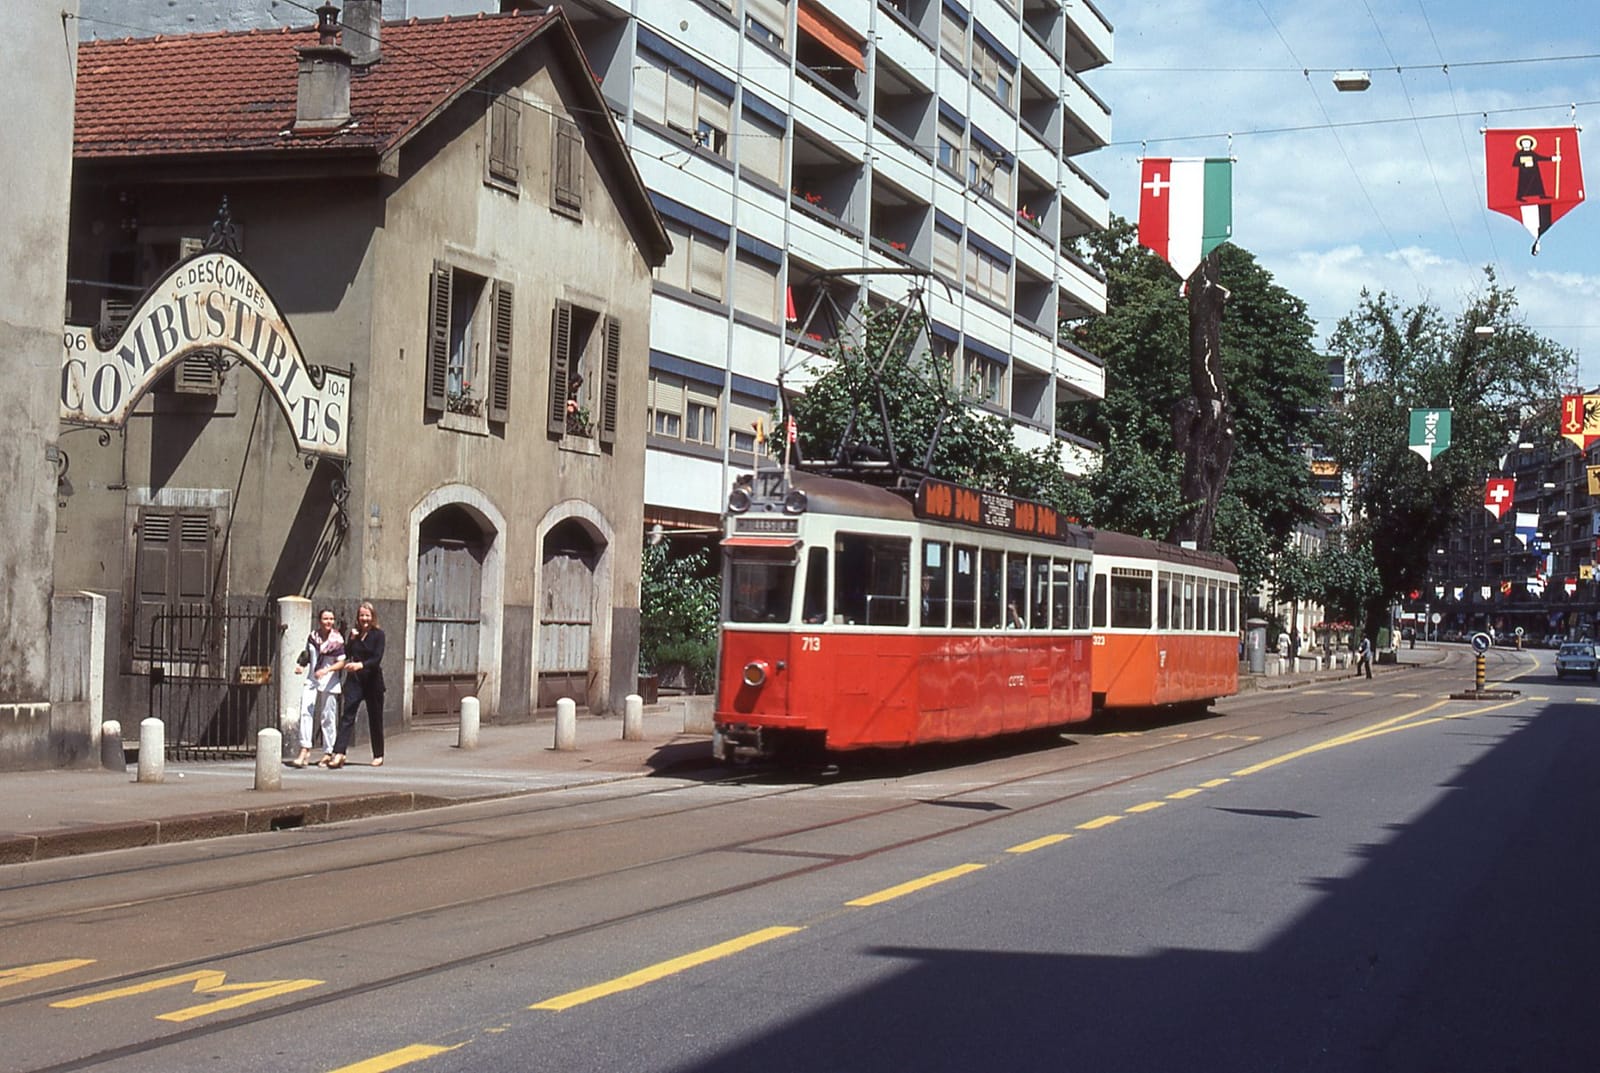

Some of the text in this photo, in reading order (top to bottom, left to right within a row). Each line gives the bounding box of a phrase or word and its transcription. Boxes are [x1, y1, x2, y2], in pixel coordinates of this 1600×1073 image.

[176, 276, 186, 289] G.
[61, 290, 341, 446] COMBUSTIBLES
[328, 380, 345, 398] 104
[801, 636, 821, 651] 713
